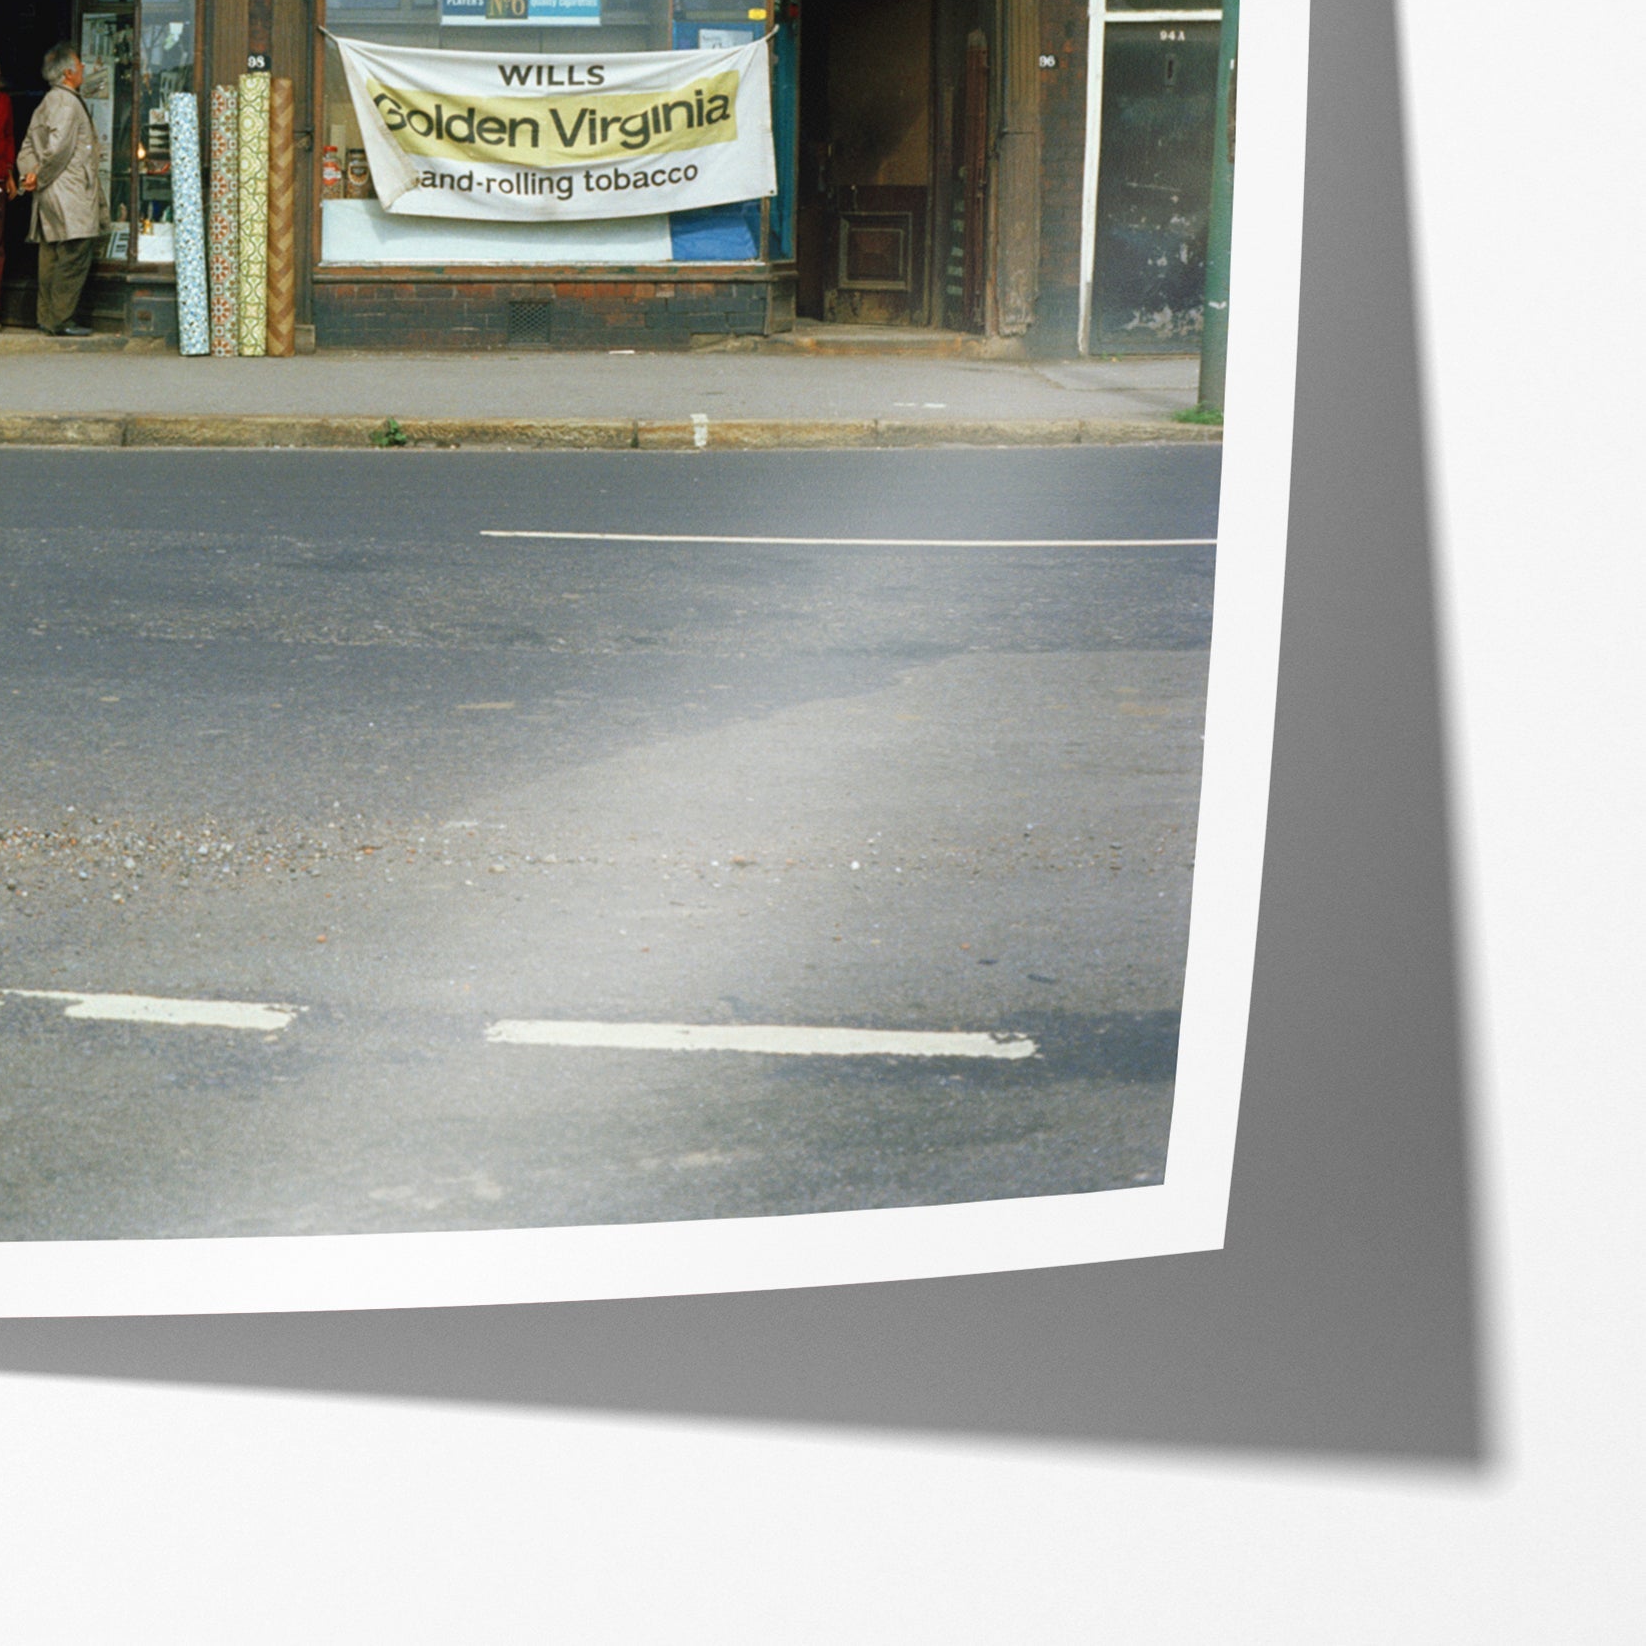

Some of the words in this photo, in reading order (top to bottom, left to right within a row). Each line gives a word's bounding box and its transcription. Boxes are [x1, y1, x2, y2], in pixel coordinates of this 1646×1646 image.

[247, 55, 265, 69] 98
[498, 65, 605, 86] WILLS
[373, 93, 540, 148] Golden
[549, 89, 731, 150] Virginia
[416, 170, 573, 201] and-rolling
[584, 164, 698, 191] tobacco
